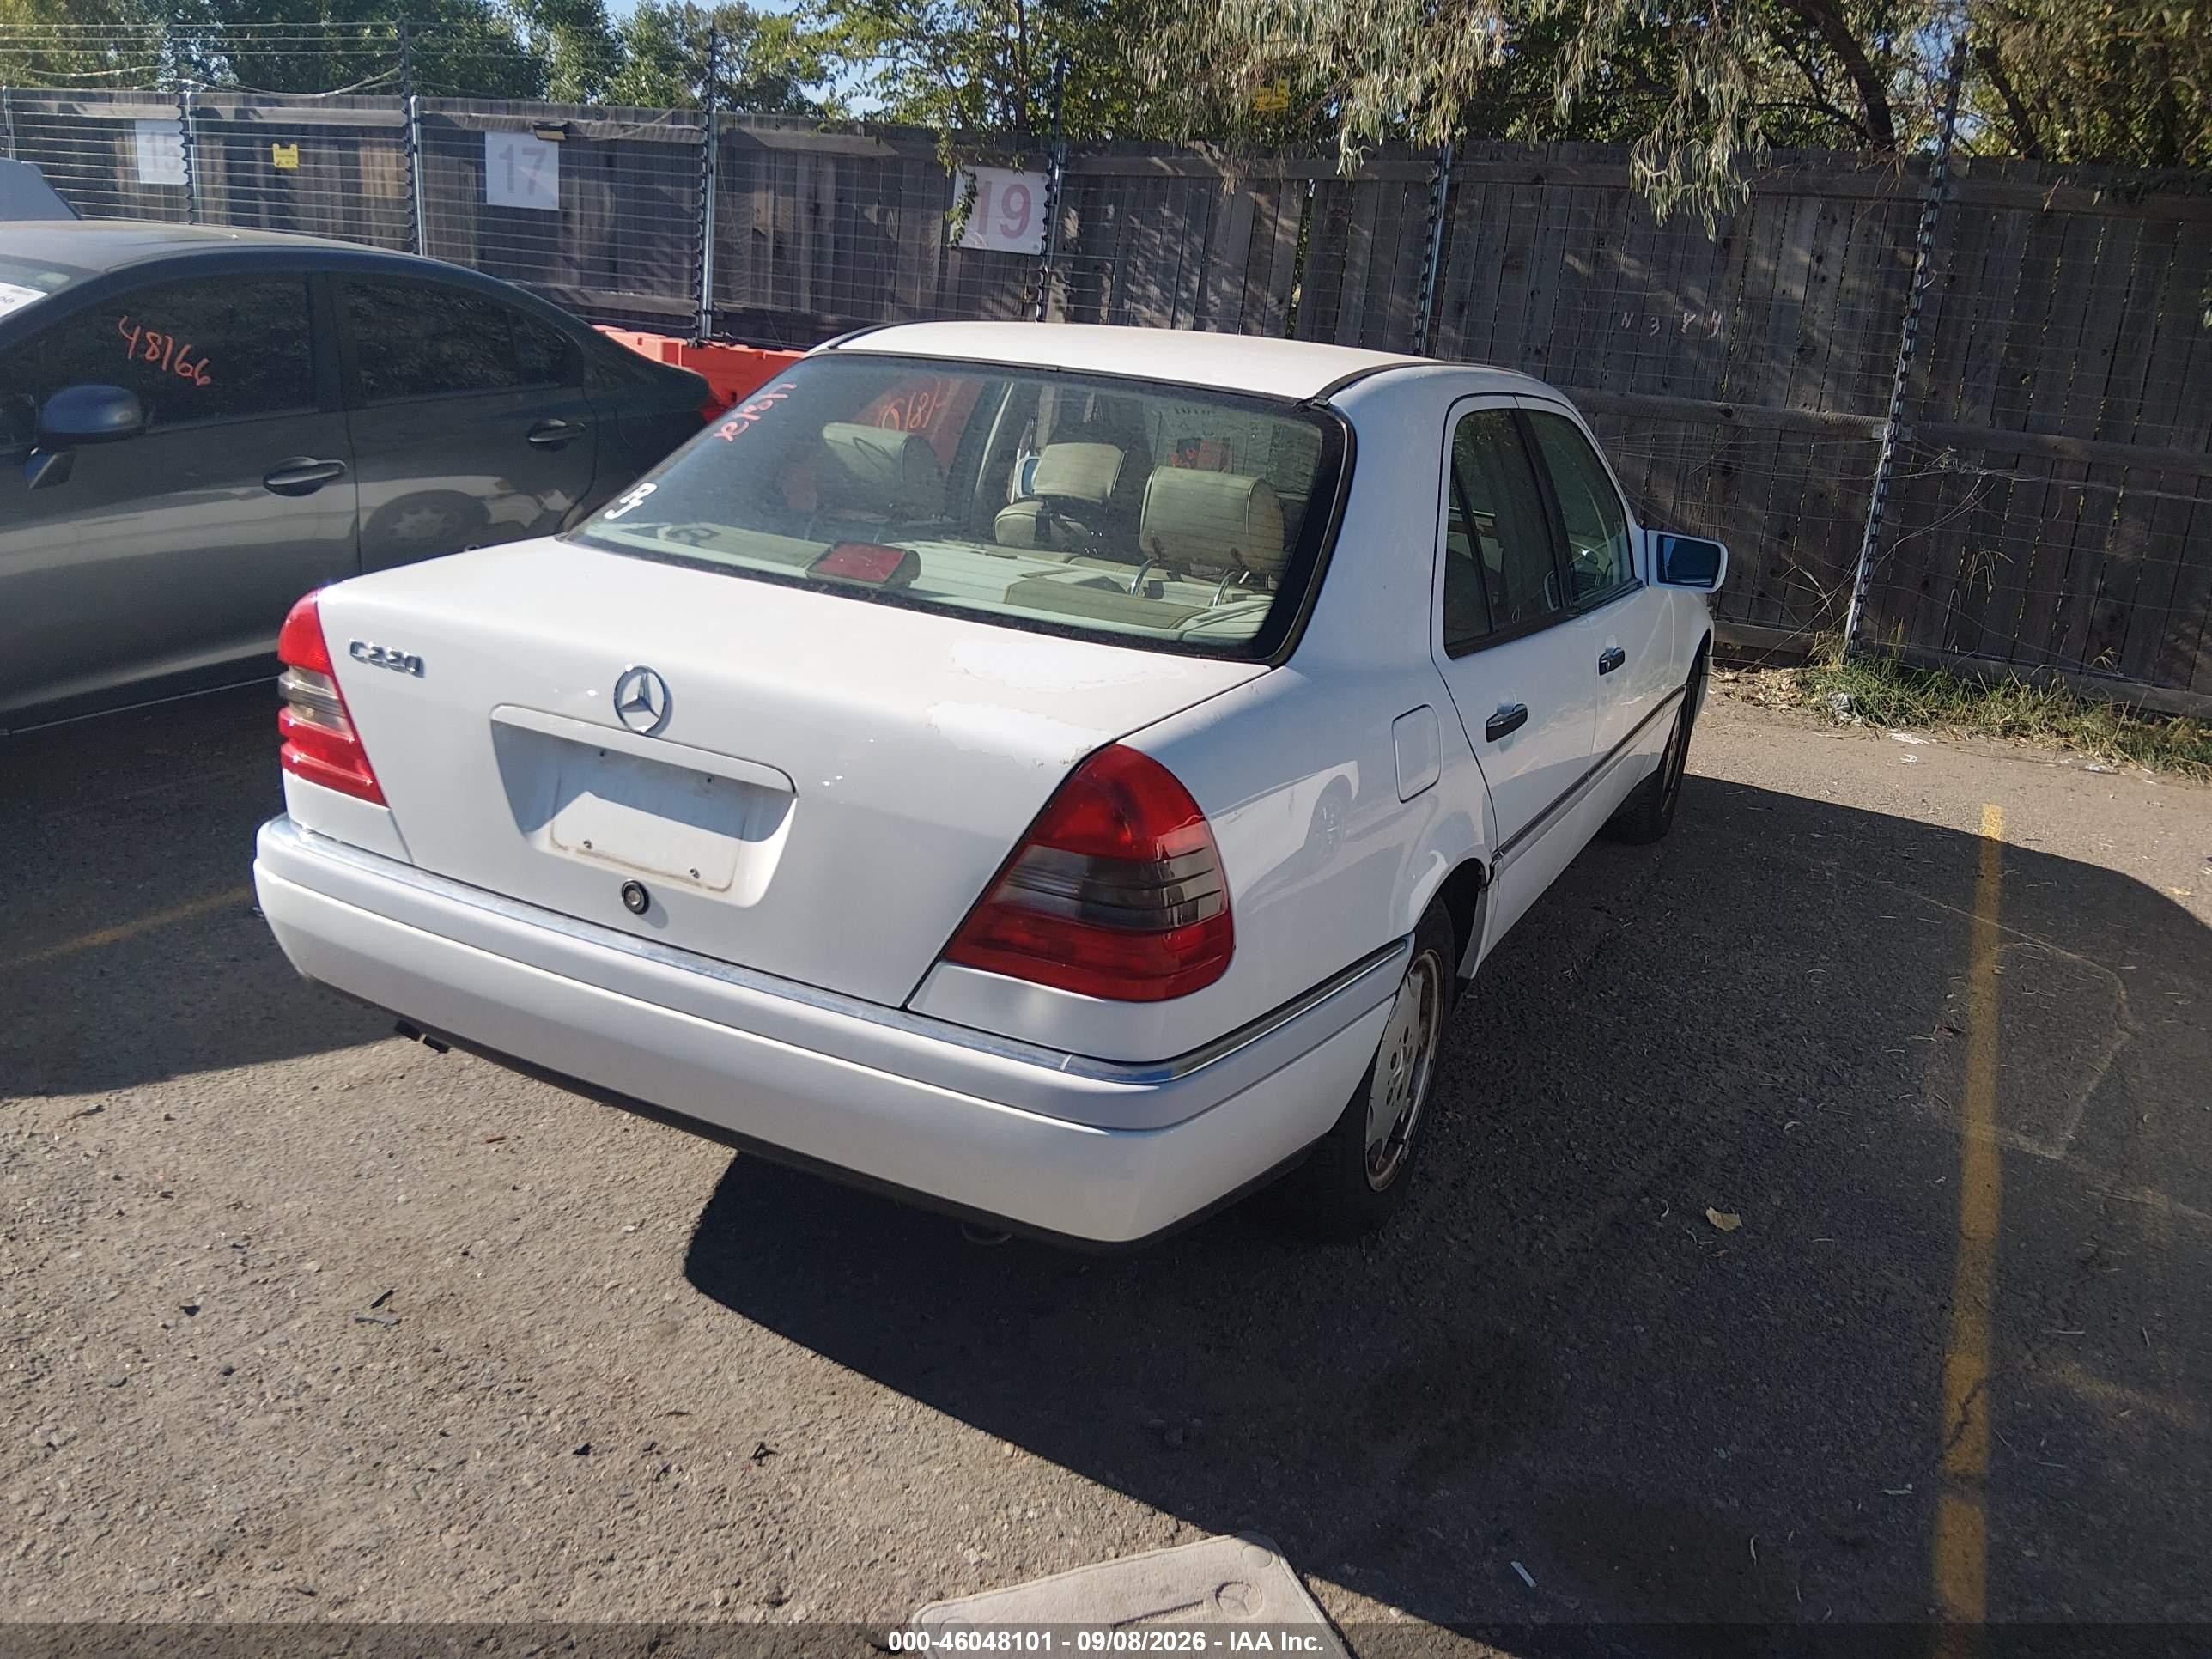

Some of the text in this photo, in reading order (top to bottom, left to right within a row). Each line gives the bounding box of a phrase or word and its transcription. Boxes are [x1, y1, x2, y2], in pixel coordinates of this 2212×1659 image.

[499, 144, 547, 196] 17
[978, 180, 1032, 240] 19
[118, 314, 213, 386] 48166
[349, 641, 424, 678] C220
